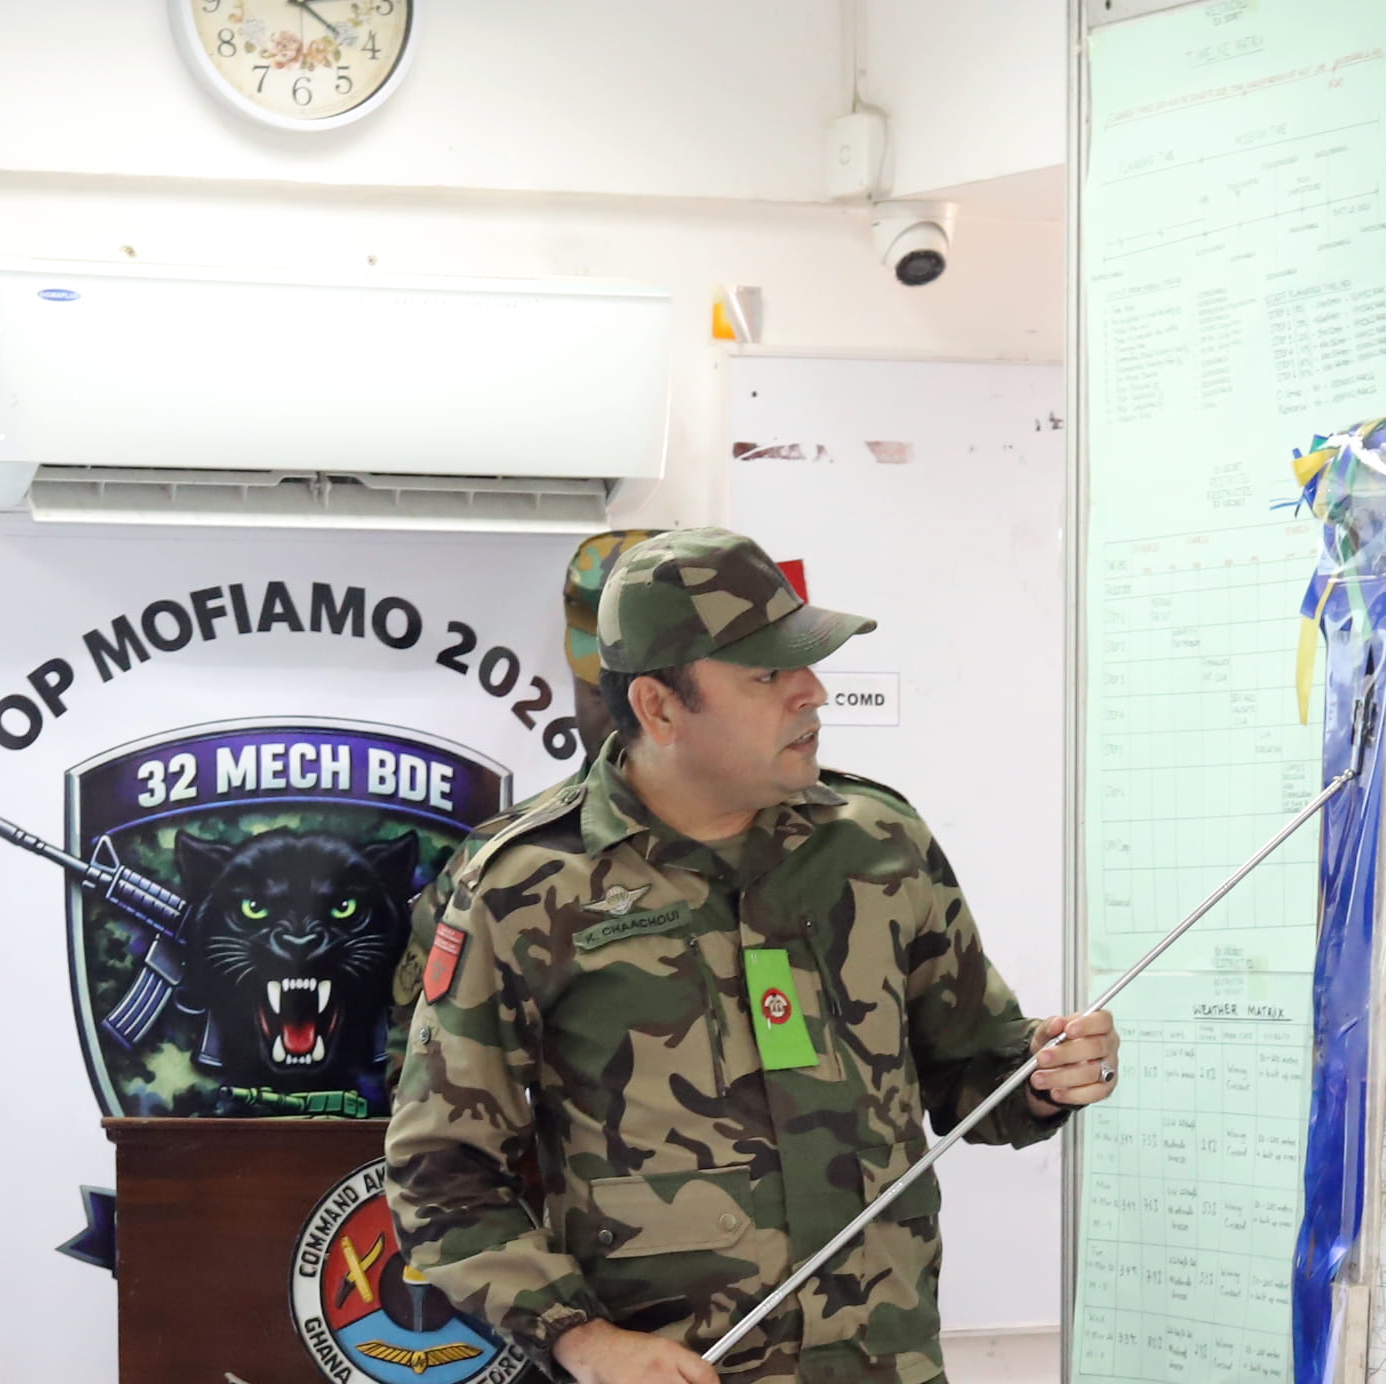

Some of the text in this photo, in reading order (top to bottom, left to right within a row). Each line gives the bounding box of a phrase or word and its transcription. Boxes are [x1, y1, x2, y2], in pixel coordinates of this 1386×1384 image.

[217, 28, 237, 57] 8
[361, 30, 381, 60] 4
[252, 66, 270, 93] 7
[292, 77, 312, 106] 6
[335, 66, 353, 95] 5
[81, 581, 425, 686] MOFIAMO
[435, 620, 583, 763] 2026
[834, 693, 885, 707] COMD
[136, 742, 456, 813] 32 MECH BDE
[1193, 1004, 1284, 1019] WEATHER MATRIX
[299, 1166, 386, 1278] COMMAND AN
